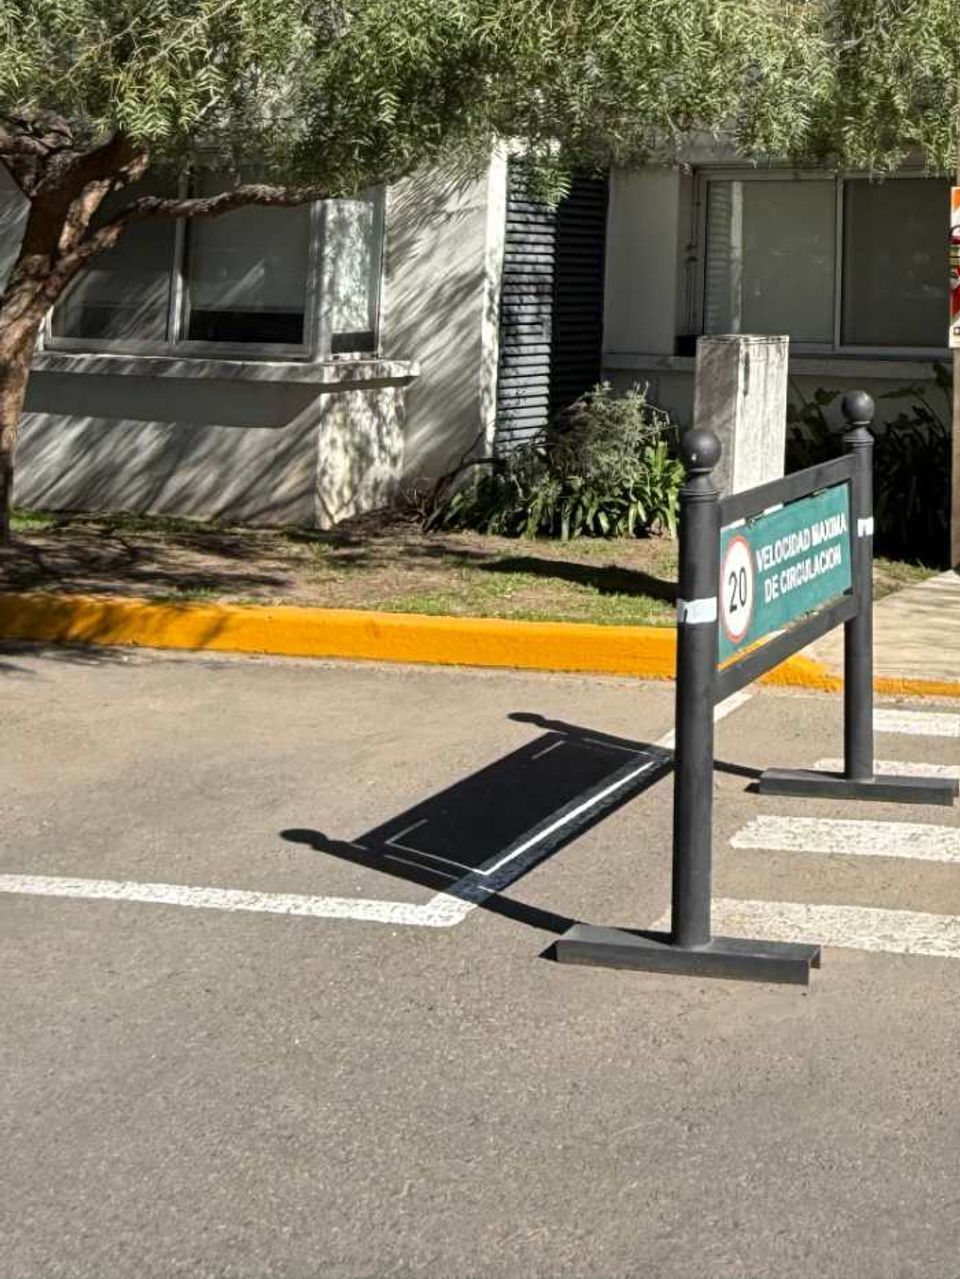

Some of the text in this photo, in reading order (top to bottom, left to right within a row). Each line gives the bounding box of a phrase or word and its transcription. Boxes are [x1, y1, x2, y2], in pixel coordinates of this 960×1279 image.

[756, 513, 848, 572] VELOCIDAD MAXIMA
[728, 567, 748, 613] 20
[764, 543, 842, 603] DE CIRCULACION
